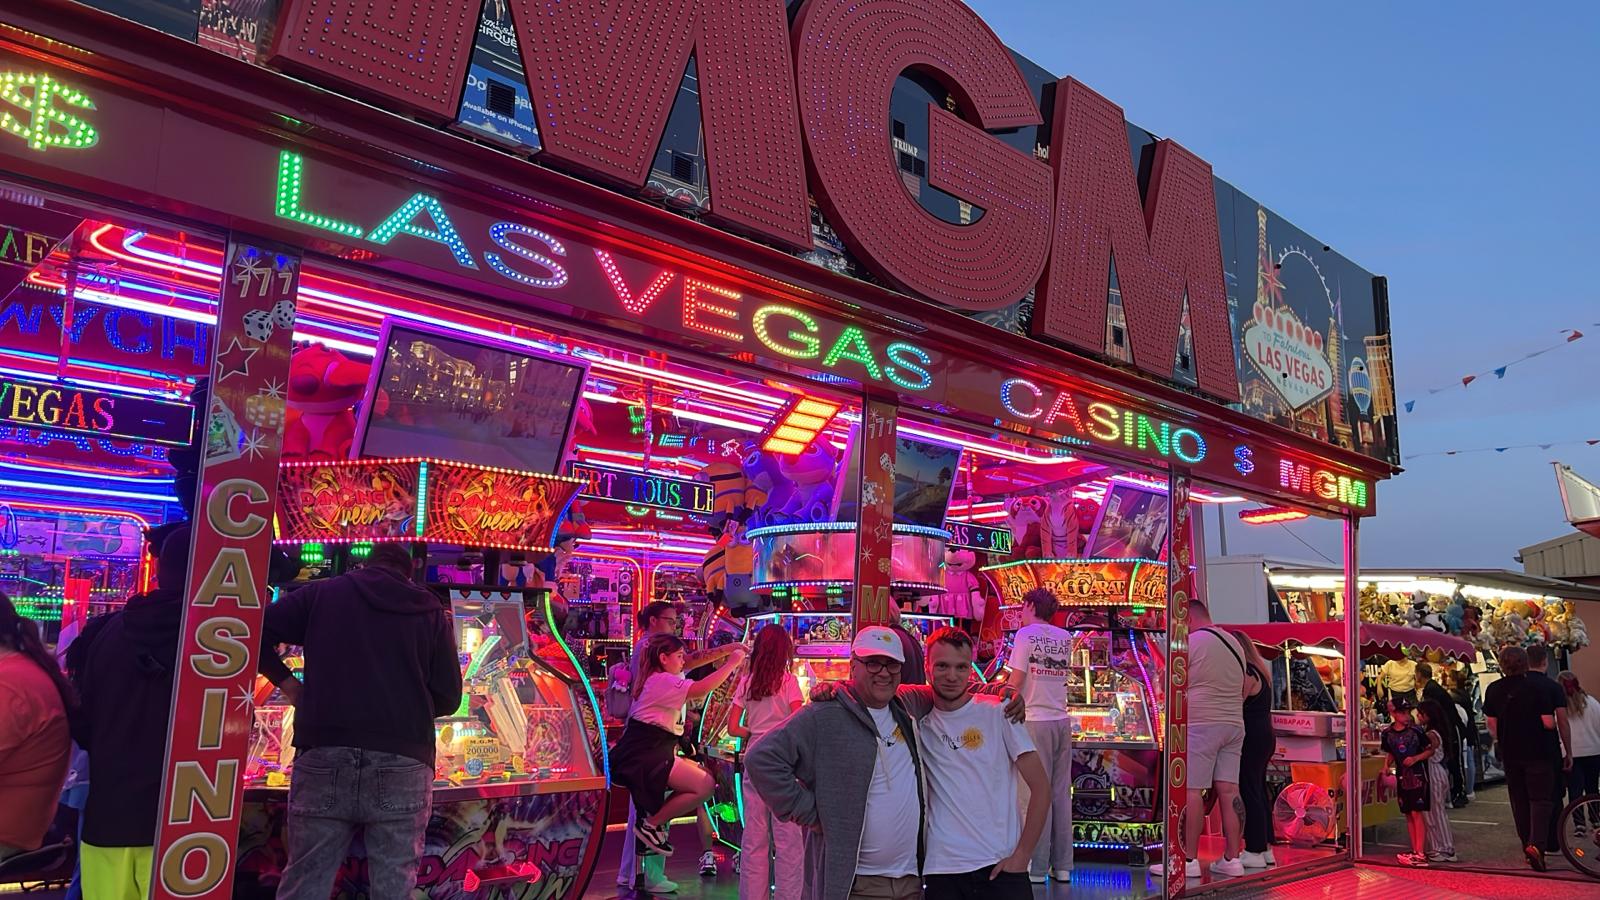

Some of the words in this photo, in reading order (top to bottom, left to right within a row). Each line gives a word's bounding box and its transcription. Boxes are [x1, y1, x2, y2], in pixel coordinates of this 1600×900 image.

[463, 101, 496, 119] Available
[508, 118, 532, 133] iPhone
[893, 137, 919, 157] TRUMP
[275, 150, 570, 289] LAS
[592, 248, 932, 390] VEGAS
[1000, 378, 1207, 464] CASINO
[1279, 458, 1367, 509] MGM
[1257, 342, 1282, 372] LAS
[1285, 354, 1325, 390] VEGAS
[629, 476, 681, 507] TOUS
[1043, 573, 1126, 597] BACCARAT
[1029, 636, 1057, 646] SHIFT
[1034, 644, 1042, 653] A
[1031, 667, 1064, 677] Formula
[160, 478, 270, 899] CASINO
[1168, 590, 1188, 788] CASINO
